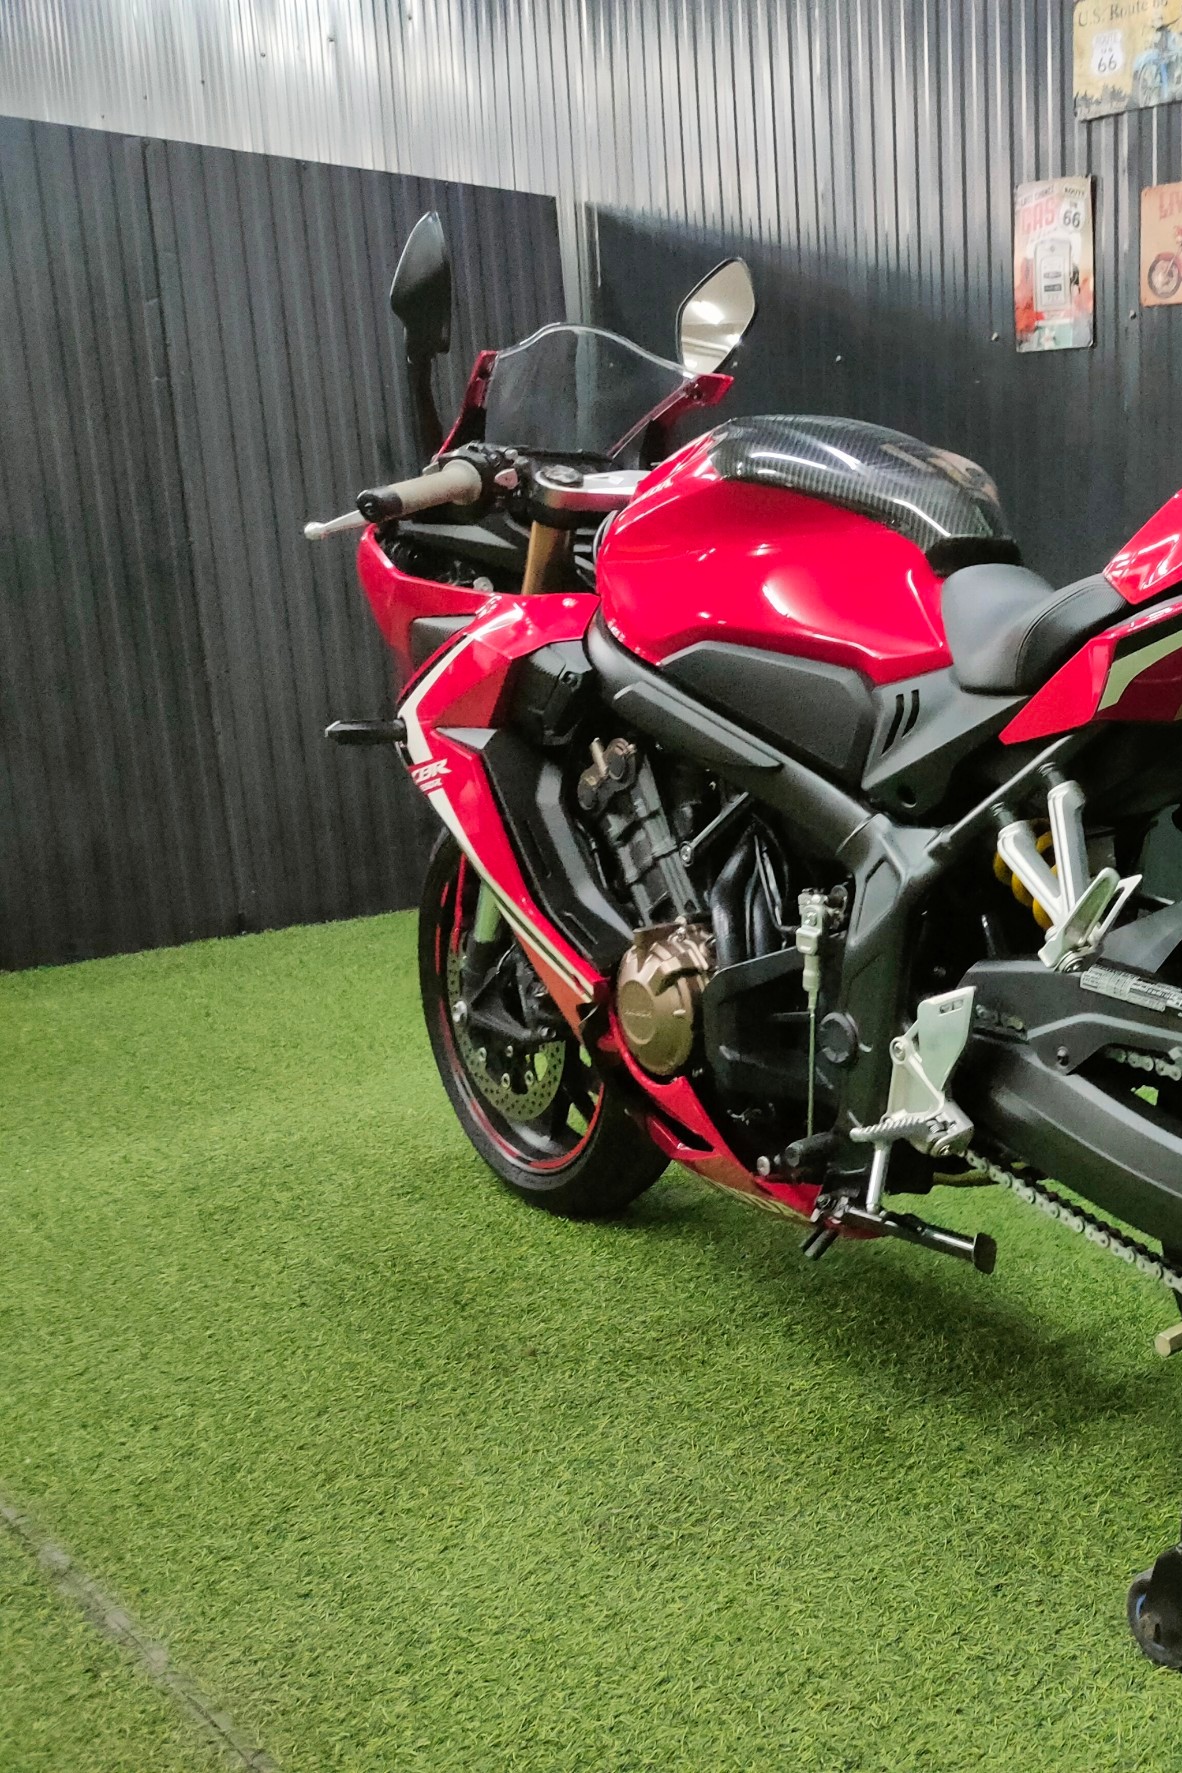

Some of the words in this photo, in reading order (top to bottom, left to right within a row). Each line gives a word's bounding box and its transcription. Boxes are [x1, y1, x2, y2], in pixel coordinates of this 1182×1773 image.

[1110, 0, 1148, 20] Route
[1097, 54, 1118, 73] 66
[1021, 196, 1057, 235] GAS
[1063, 209, 1081, 228] 66
